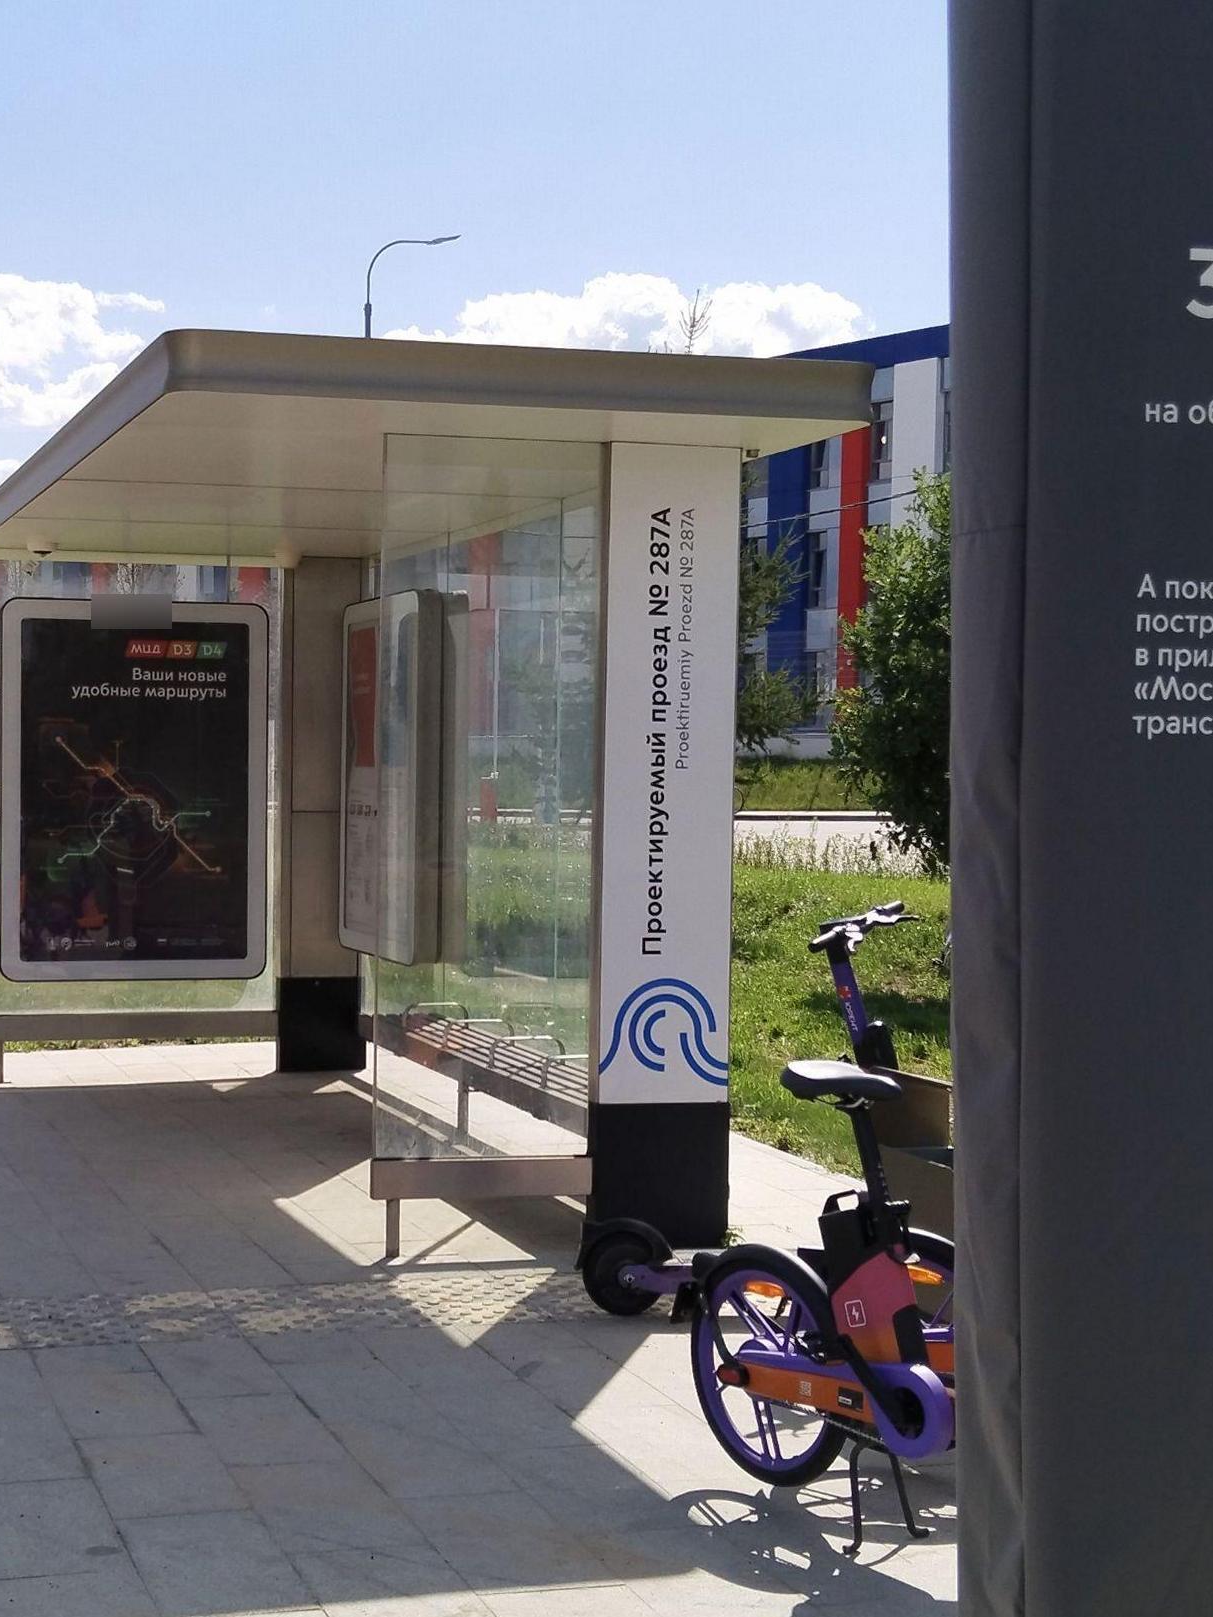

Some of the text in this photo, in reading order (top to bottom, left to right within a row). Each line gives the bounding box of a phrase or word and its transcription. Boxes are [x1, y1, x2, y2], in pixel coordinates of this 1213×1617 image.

[1144, 403, 1178, 423] на
[1137, 573, 1213, 600] А пок
[675, 508, 695, 770] Proektiruemiy Proezd № 287A
[1136, 614, 1213, 640] постр
[173, 644, 193, 656] D3
[202, 645, 222, 657] D4
[1135, 648, 1149, 666] в
[132, 667, 227, 683] Ваши новые
[71, 682, 227, 701] удобные маршруты
[1133, 675, 1213, 702] «Мос
[642, 507, 672, 955] Проектируемый проезд № 287А
[1132, 715, 1213, 741] транс
